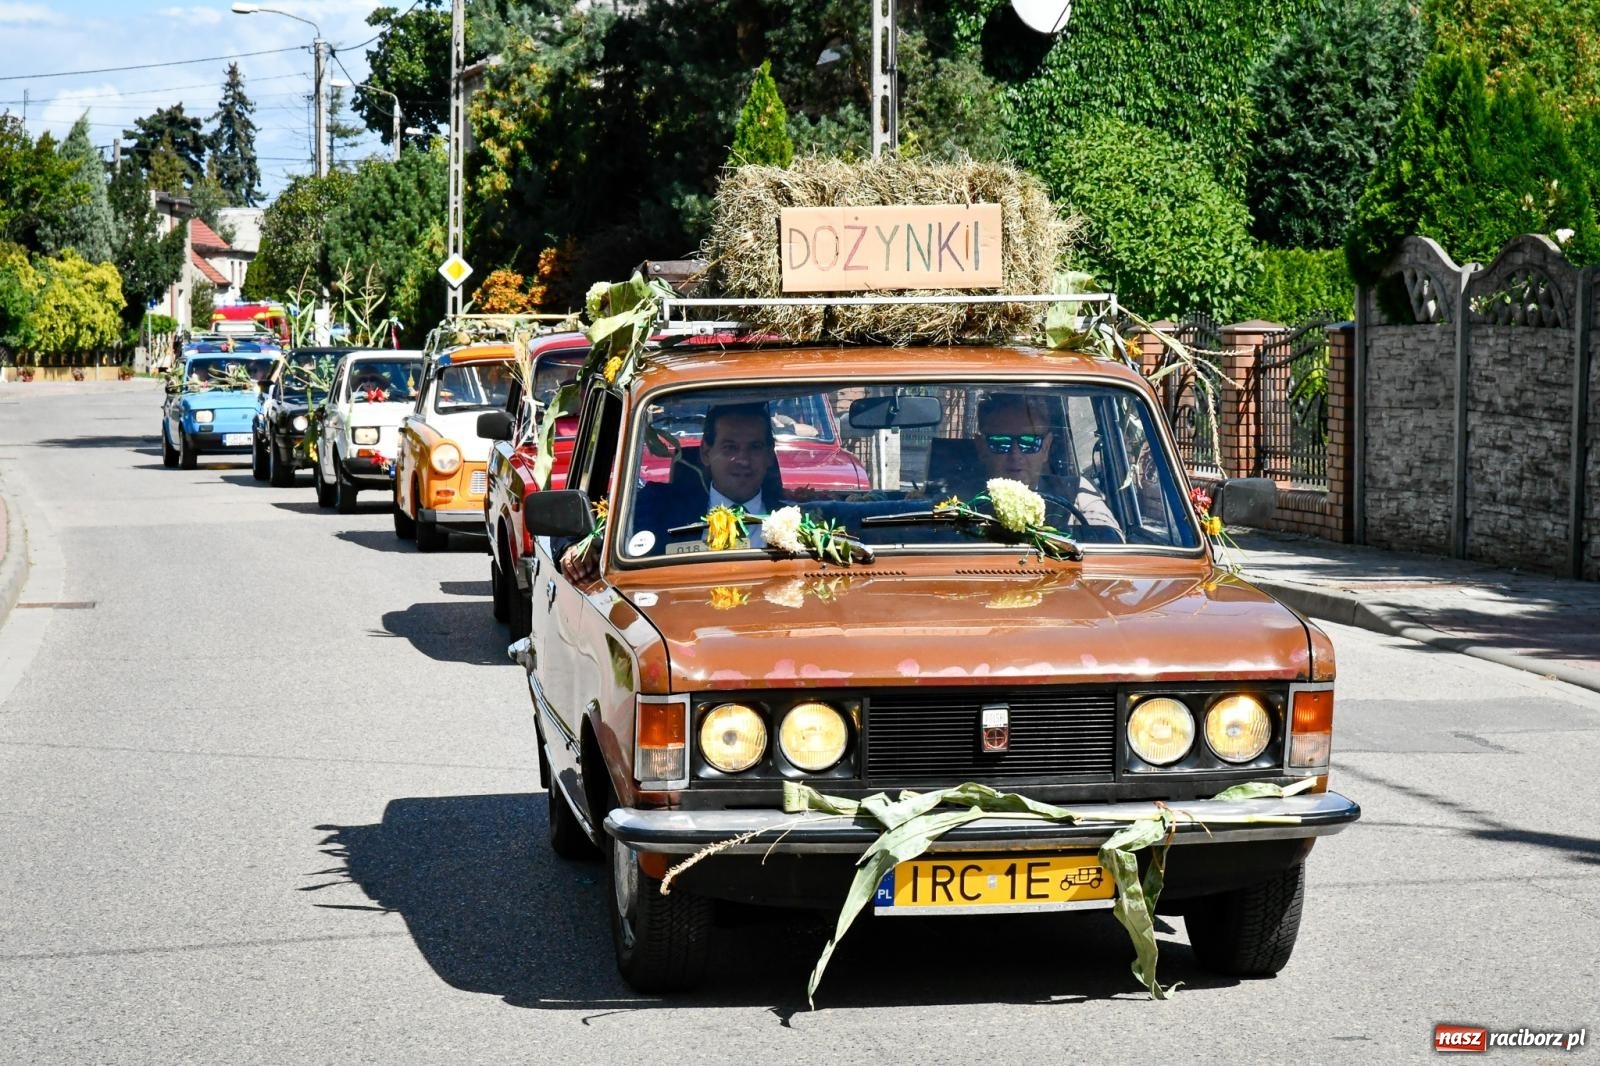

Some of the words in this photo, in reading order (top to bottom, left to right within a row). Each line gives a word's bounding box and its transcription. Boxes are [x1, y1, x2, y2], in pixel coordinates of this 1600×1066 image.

[877, 888, 893, 900] PL
[911, 864, 984, 903] IRC
[1004, 861, 1051, 900] 1E
